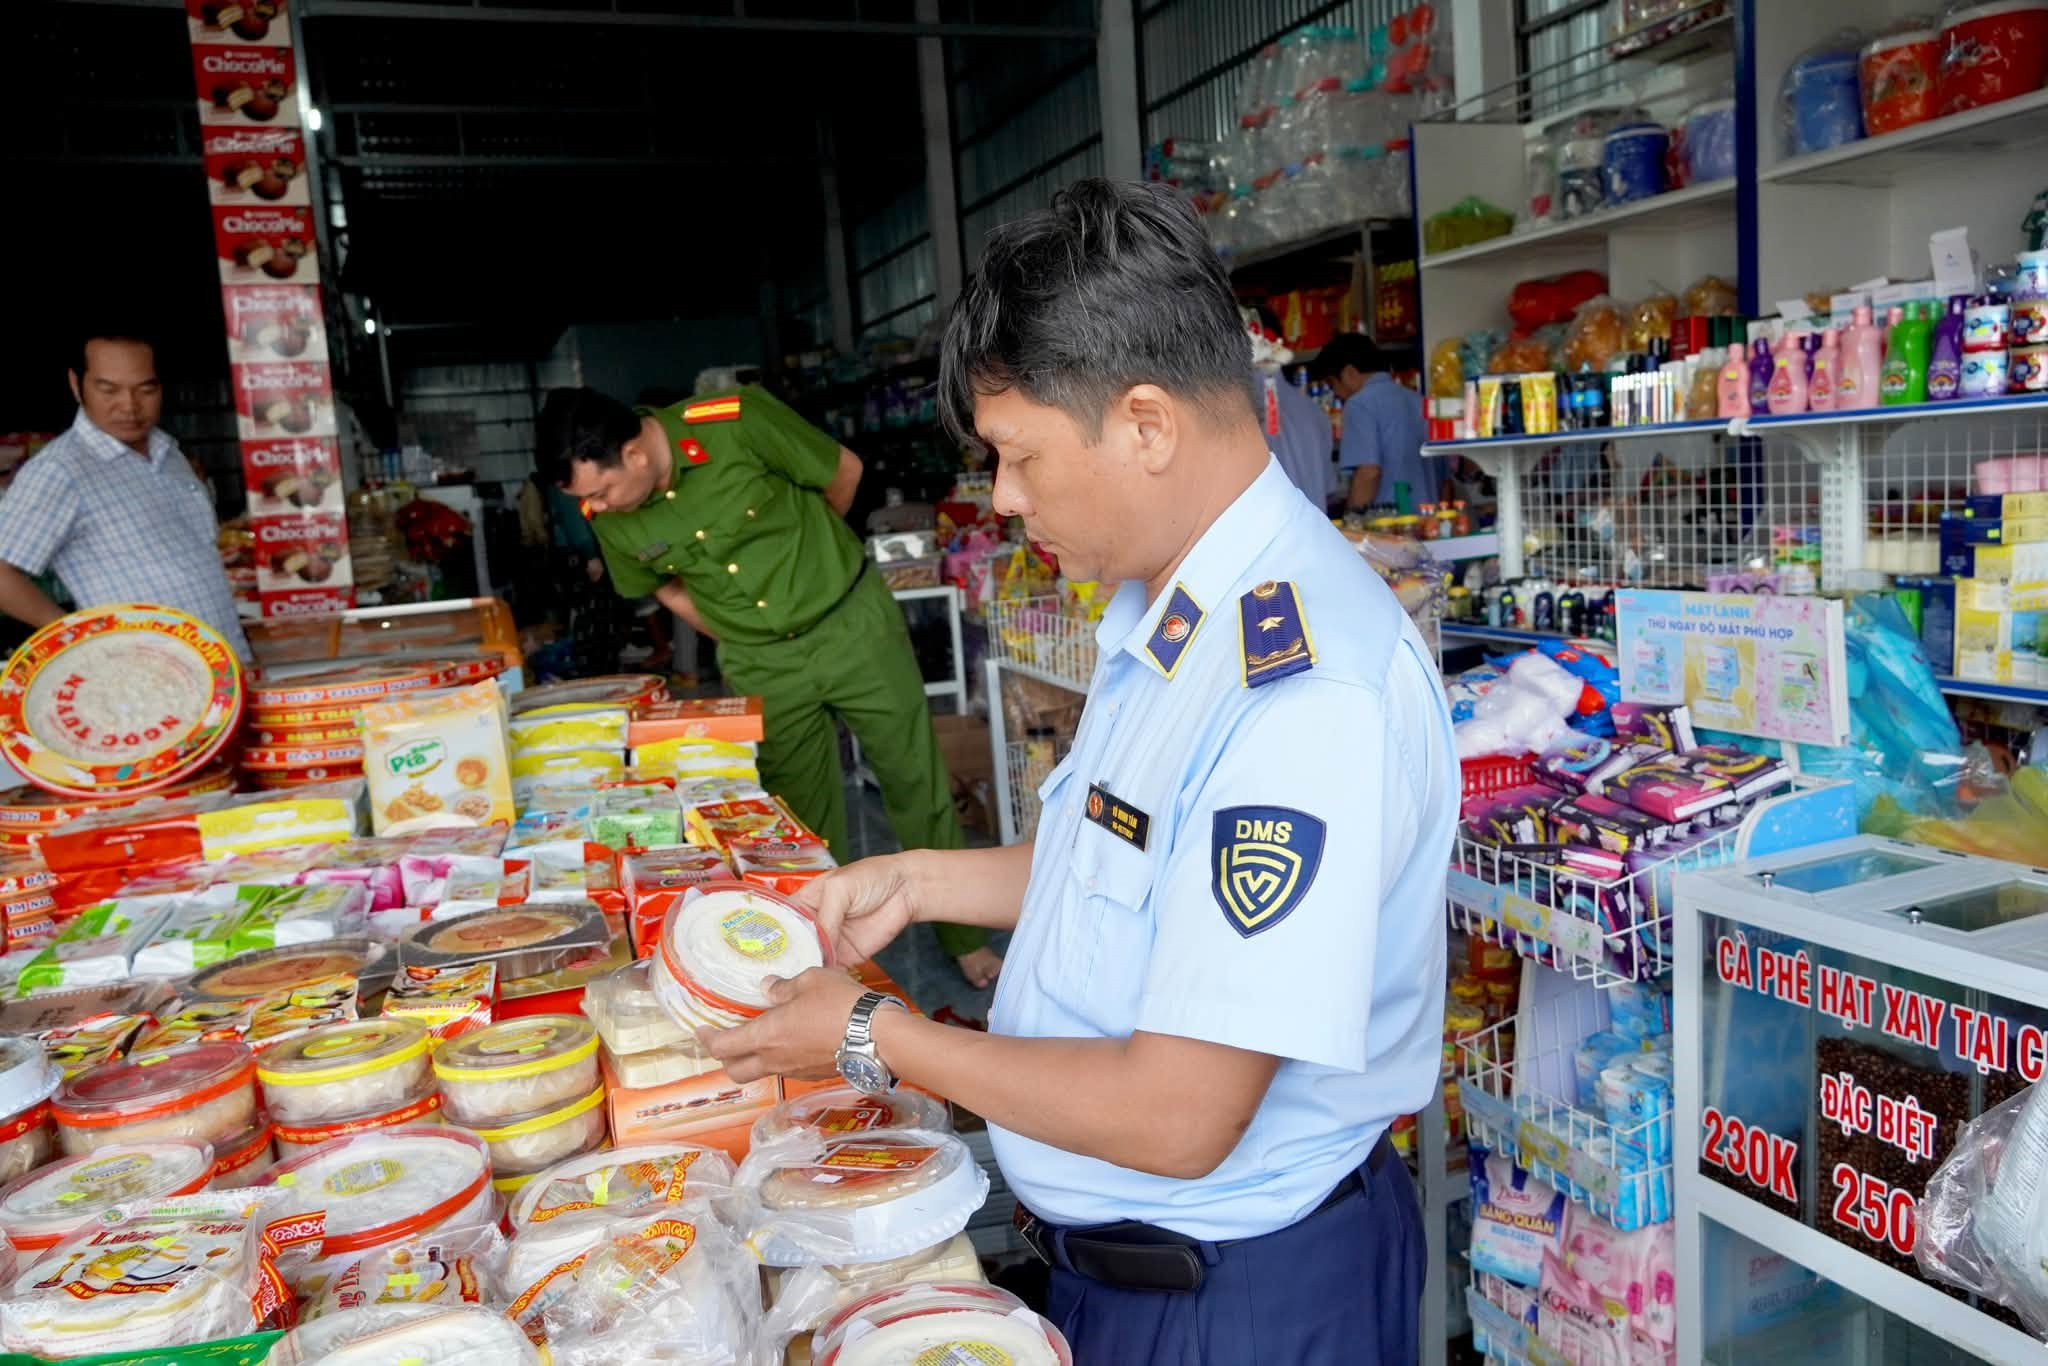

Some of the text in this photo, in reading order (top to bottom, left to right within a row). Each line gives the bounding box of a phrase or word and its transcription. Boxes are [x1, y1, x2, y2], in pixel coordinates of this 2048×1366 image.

[203, 55, 286, 74] ChocoPie
[223, 216, 304, 234] ChocoPie
[242, 372, 322, 389] ChocoPie
[251, 449, 331, 467] ChocoPie
[260, 524, 340, 544] ChocoPie
[271, 600, 349, 618] ChocoPie
[1669, 620, 1697, 632] NGAY
[1235, 819, 1293, 844] DMS
[1717, 931, 2048, 1082] CÀ PHÊ HẠT XAY TẠI C
[1821, 1072, 1937, 1162] ĐẶC BIỆT
[1702, 1107, 1798, 1202] 230K
[1833, 1163, 1922, 1255] 250
